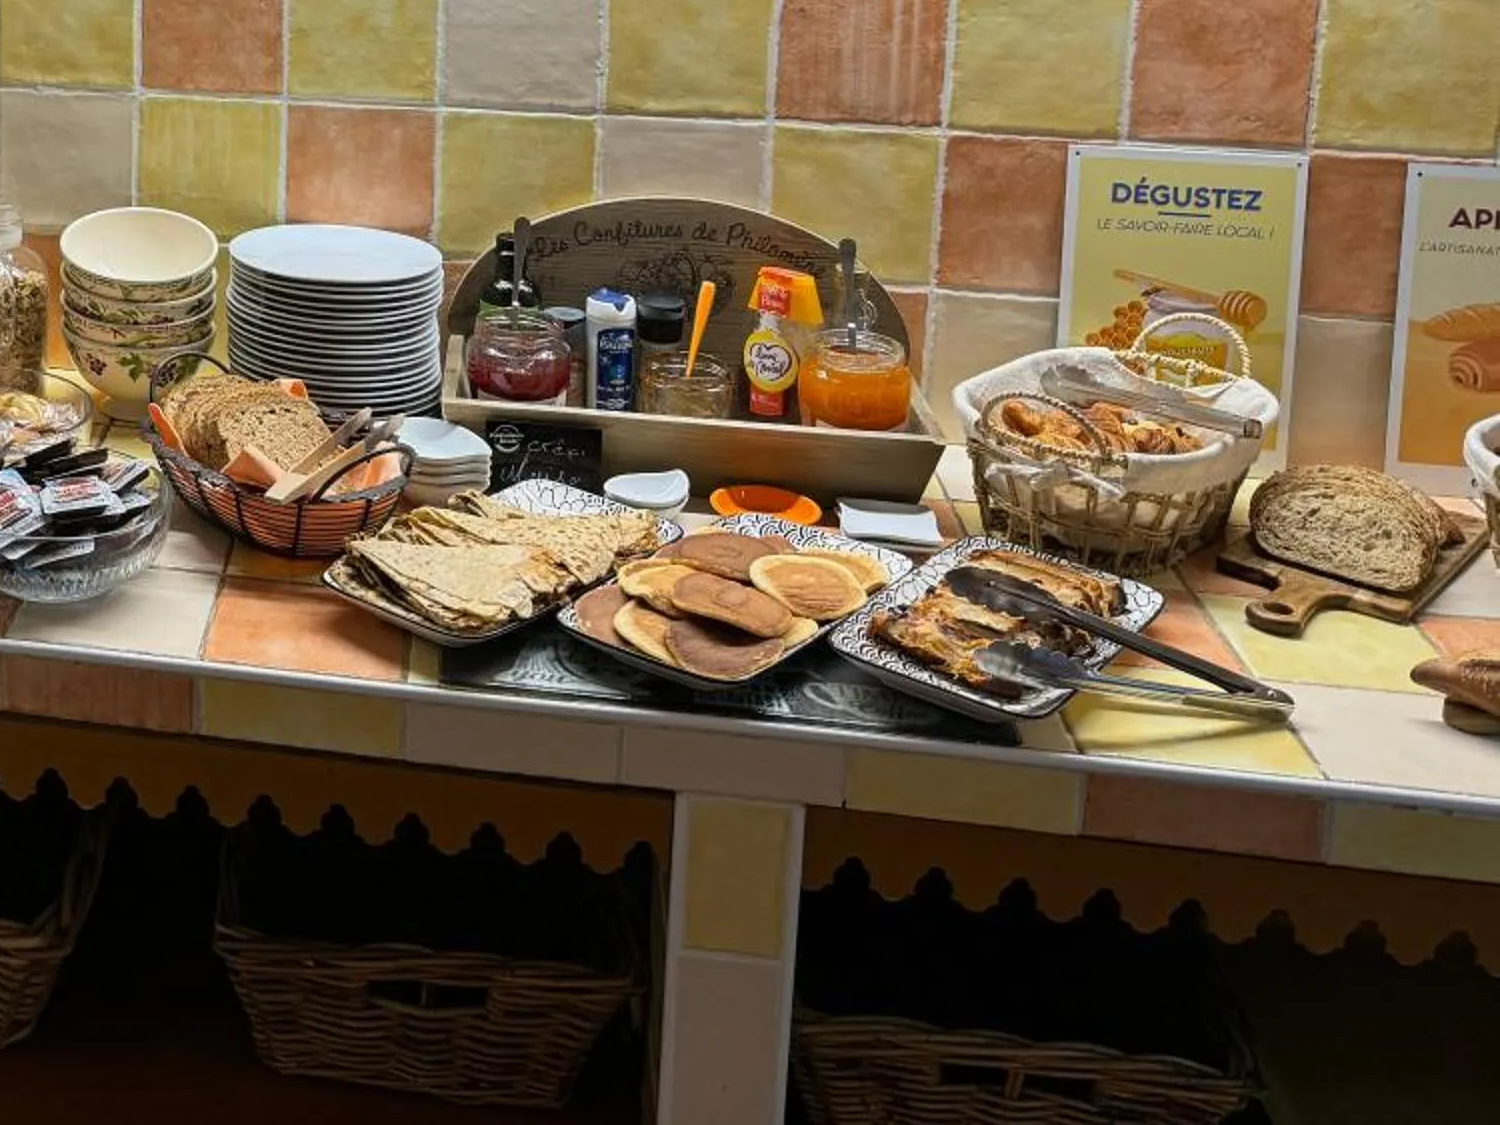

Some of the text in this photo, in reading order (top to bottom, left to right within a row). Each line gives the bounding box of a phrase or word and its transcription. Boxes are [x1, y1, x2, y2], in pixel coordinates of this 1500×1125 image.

[1111, 176, 1263, 212] DÉGUSTEZ
[573, 220, 683, 246] Confitures
[692, 222, 717, 241] de
[1097, 218, 1111, 231] LE
[1117, 218, 1213, 236] SAVOIR-FAIRE
[1217, 224, 1265, 240] LOCAL
